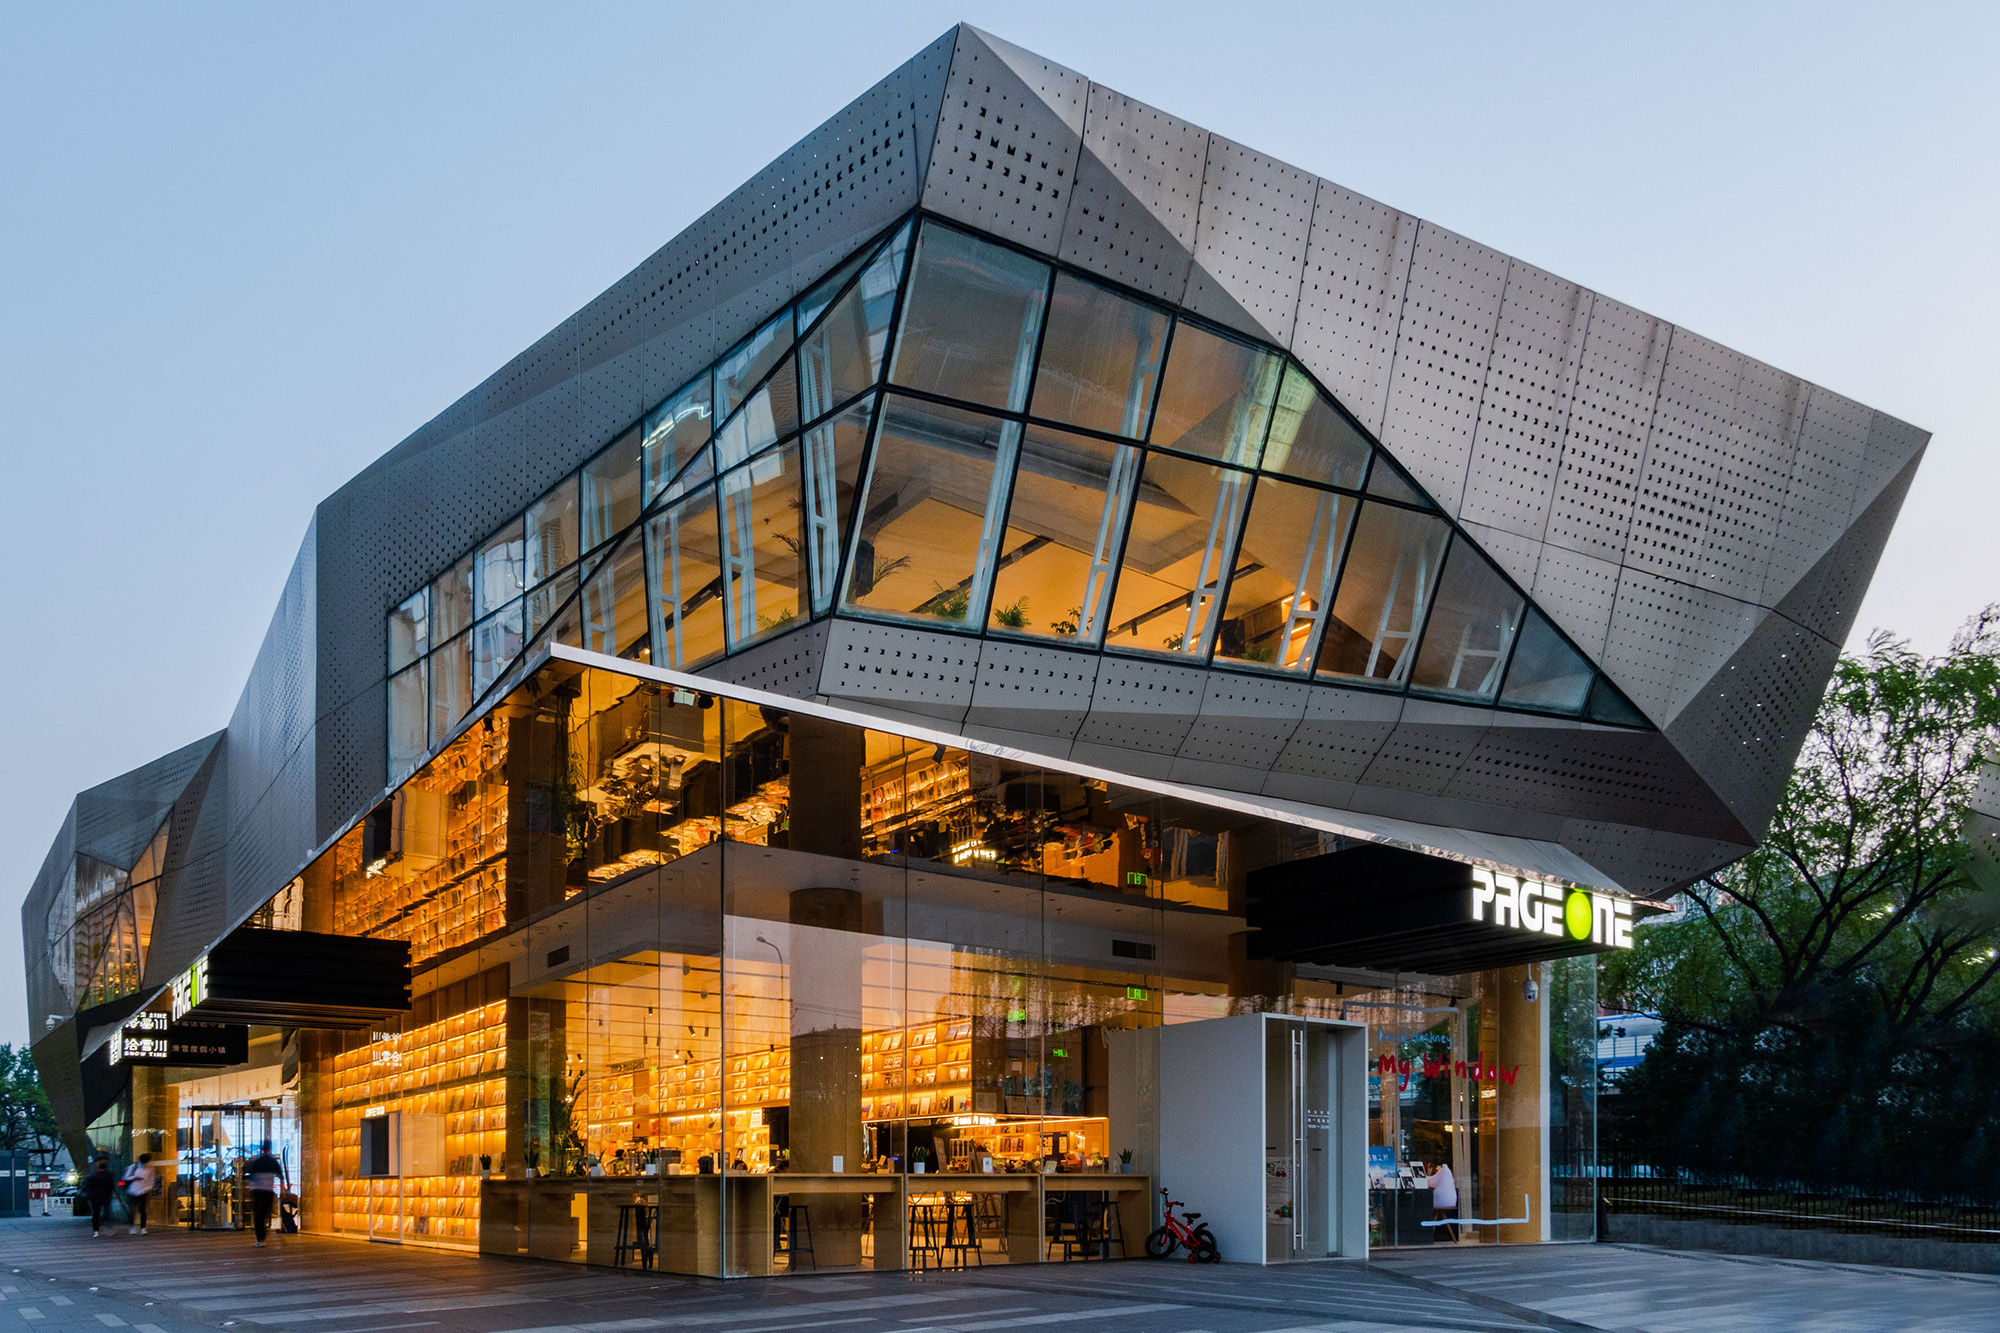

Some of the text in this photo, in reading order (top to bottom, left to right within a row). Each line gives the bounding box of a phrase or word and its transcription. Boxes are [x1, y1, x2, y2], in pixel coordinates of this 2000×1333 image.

[124, 1038, 168, 1052] 拾雪川
[1411, 1031, 1452, 1049] Hockney
[1378, 1051, 1519, 1091] My Window
